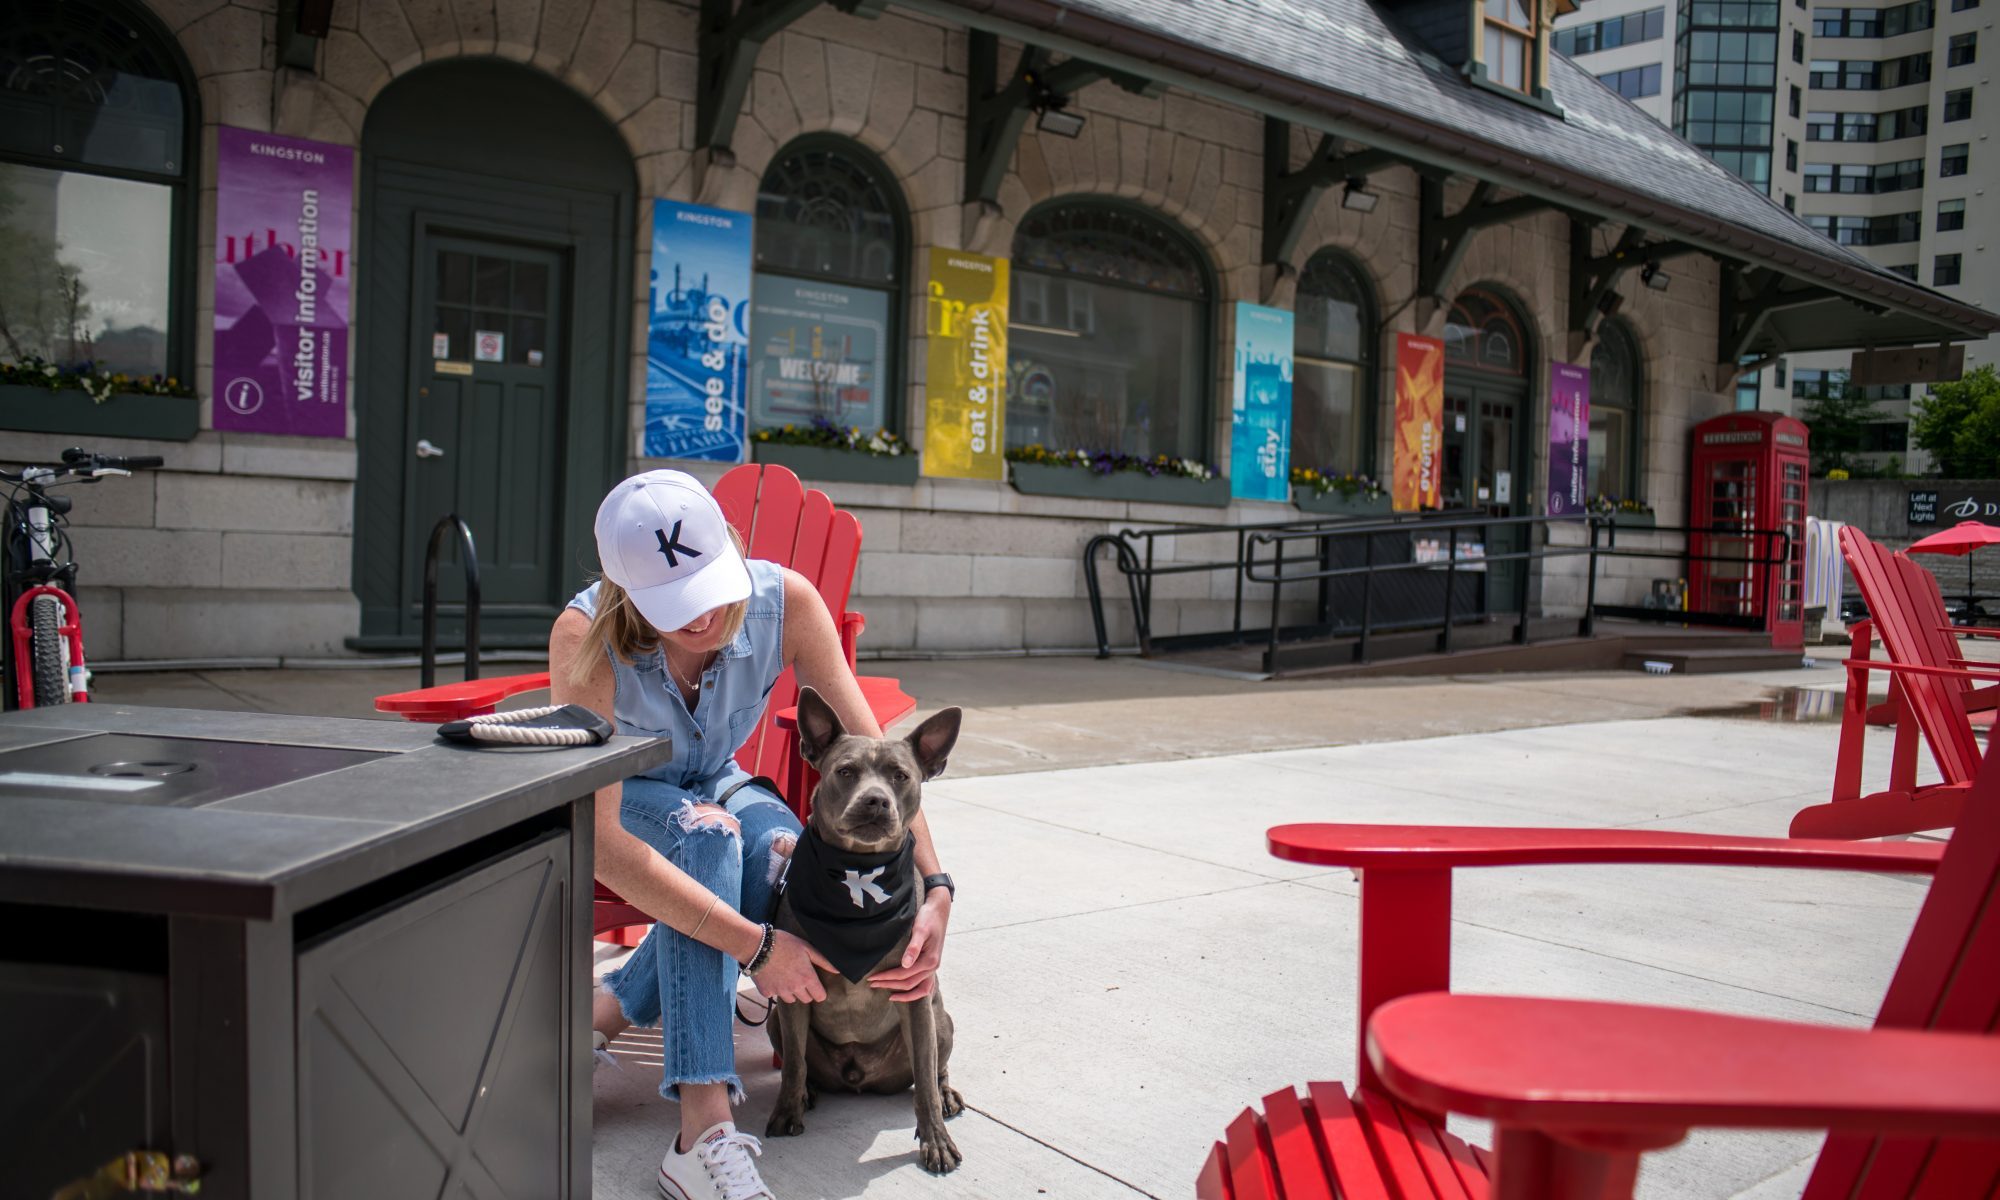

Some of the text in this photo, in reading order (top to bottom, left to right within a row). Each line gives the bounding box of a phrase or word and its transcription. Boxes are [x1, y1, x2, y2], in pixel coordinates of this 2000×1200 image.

[250, 142, 325, 164] KINGSTON
[676, 210, 732, 229] KINGSTON
[947, 257, 992, 273] KINGSTON
[295, 189, 318, 402] visitor information
[795, 288, 849, 304] KINGSTON
[701, 302, 729, 432] see & do
[779, 357, 861, 385] WELCOME
[968, 309, 989, 454] eat & drink
[1264, 428, 1280, 479] stay
[1420, 422, 1433, 492] events
[1911, 493, 1937, 502] Left at
[1913, 502, 1933, 511] Next
[1910, 512, 1936, 522] Lights
[654, 519, 703, 568] K
[841, 865, 893, 909] K
